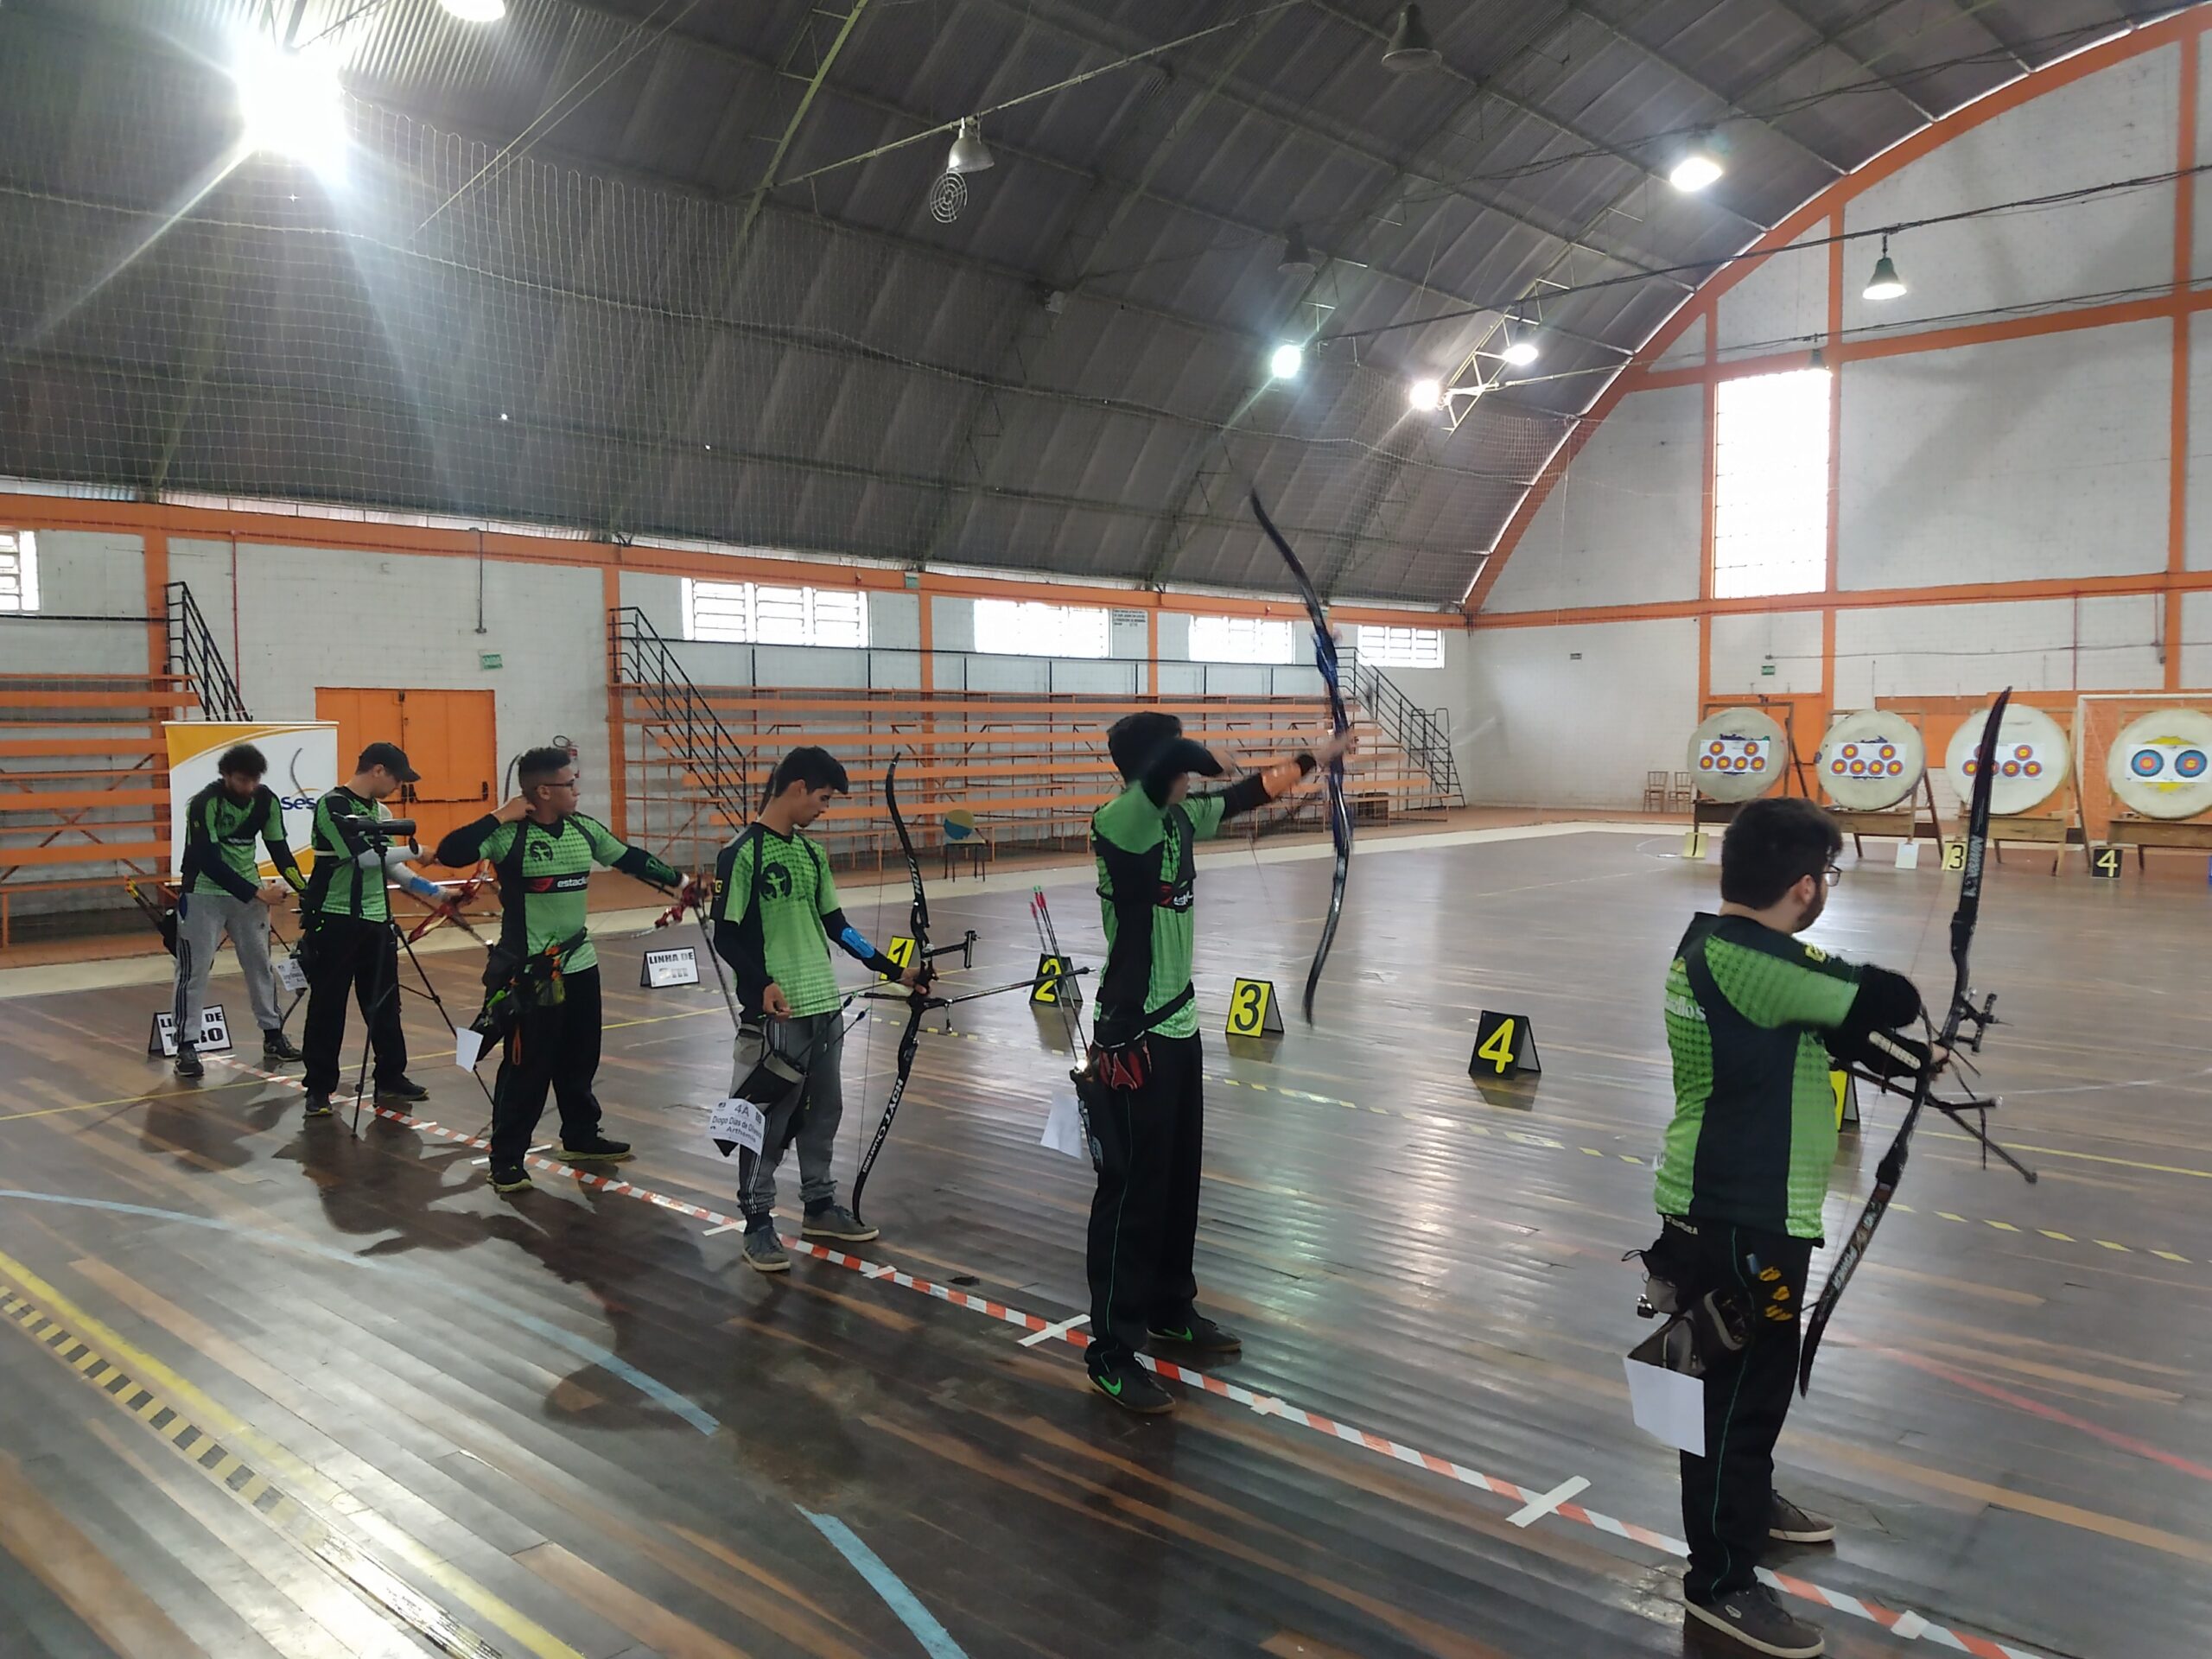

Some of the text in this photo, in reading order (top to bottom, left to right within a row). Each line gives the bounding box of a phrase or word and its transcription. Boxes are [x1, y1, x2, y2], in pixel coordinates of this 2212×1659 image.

[280, 796, 318, 810] Ses
[1949, 844, 1964, 869] 3
[2096, 849, 2118, 878] 4
[649, 951, 694, 964] LINHA DE
[893, 939, 908, 967] 1
[1035, 958, 1062, 1002] 2
[205, 1012, 223, 1023] DE
[1234, 983, 1262, 1031] 3
[166, 1027, 224, 1046] TRO
[1478, 1018, 1515, 1073] 4
[712, 1115, 728, 1126] Diogo
[728, 1116, 741, 1127] Dias
[734, 1104, 749, 1117] 4A
